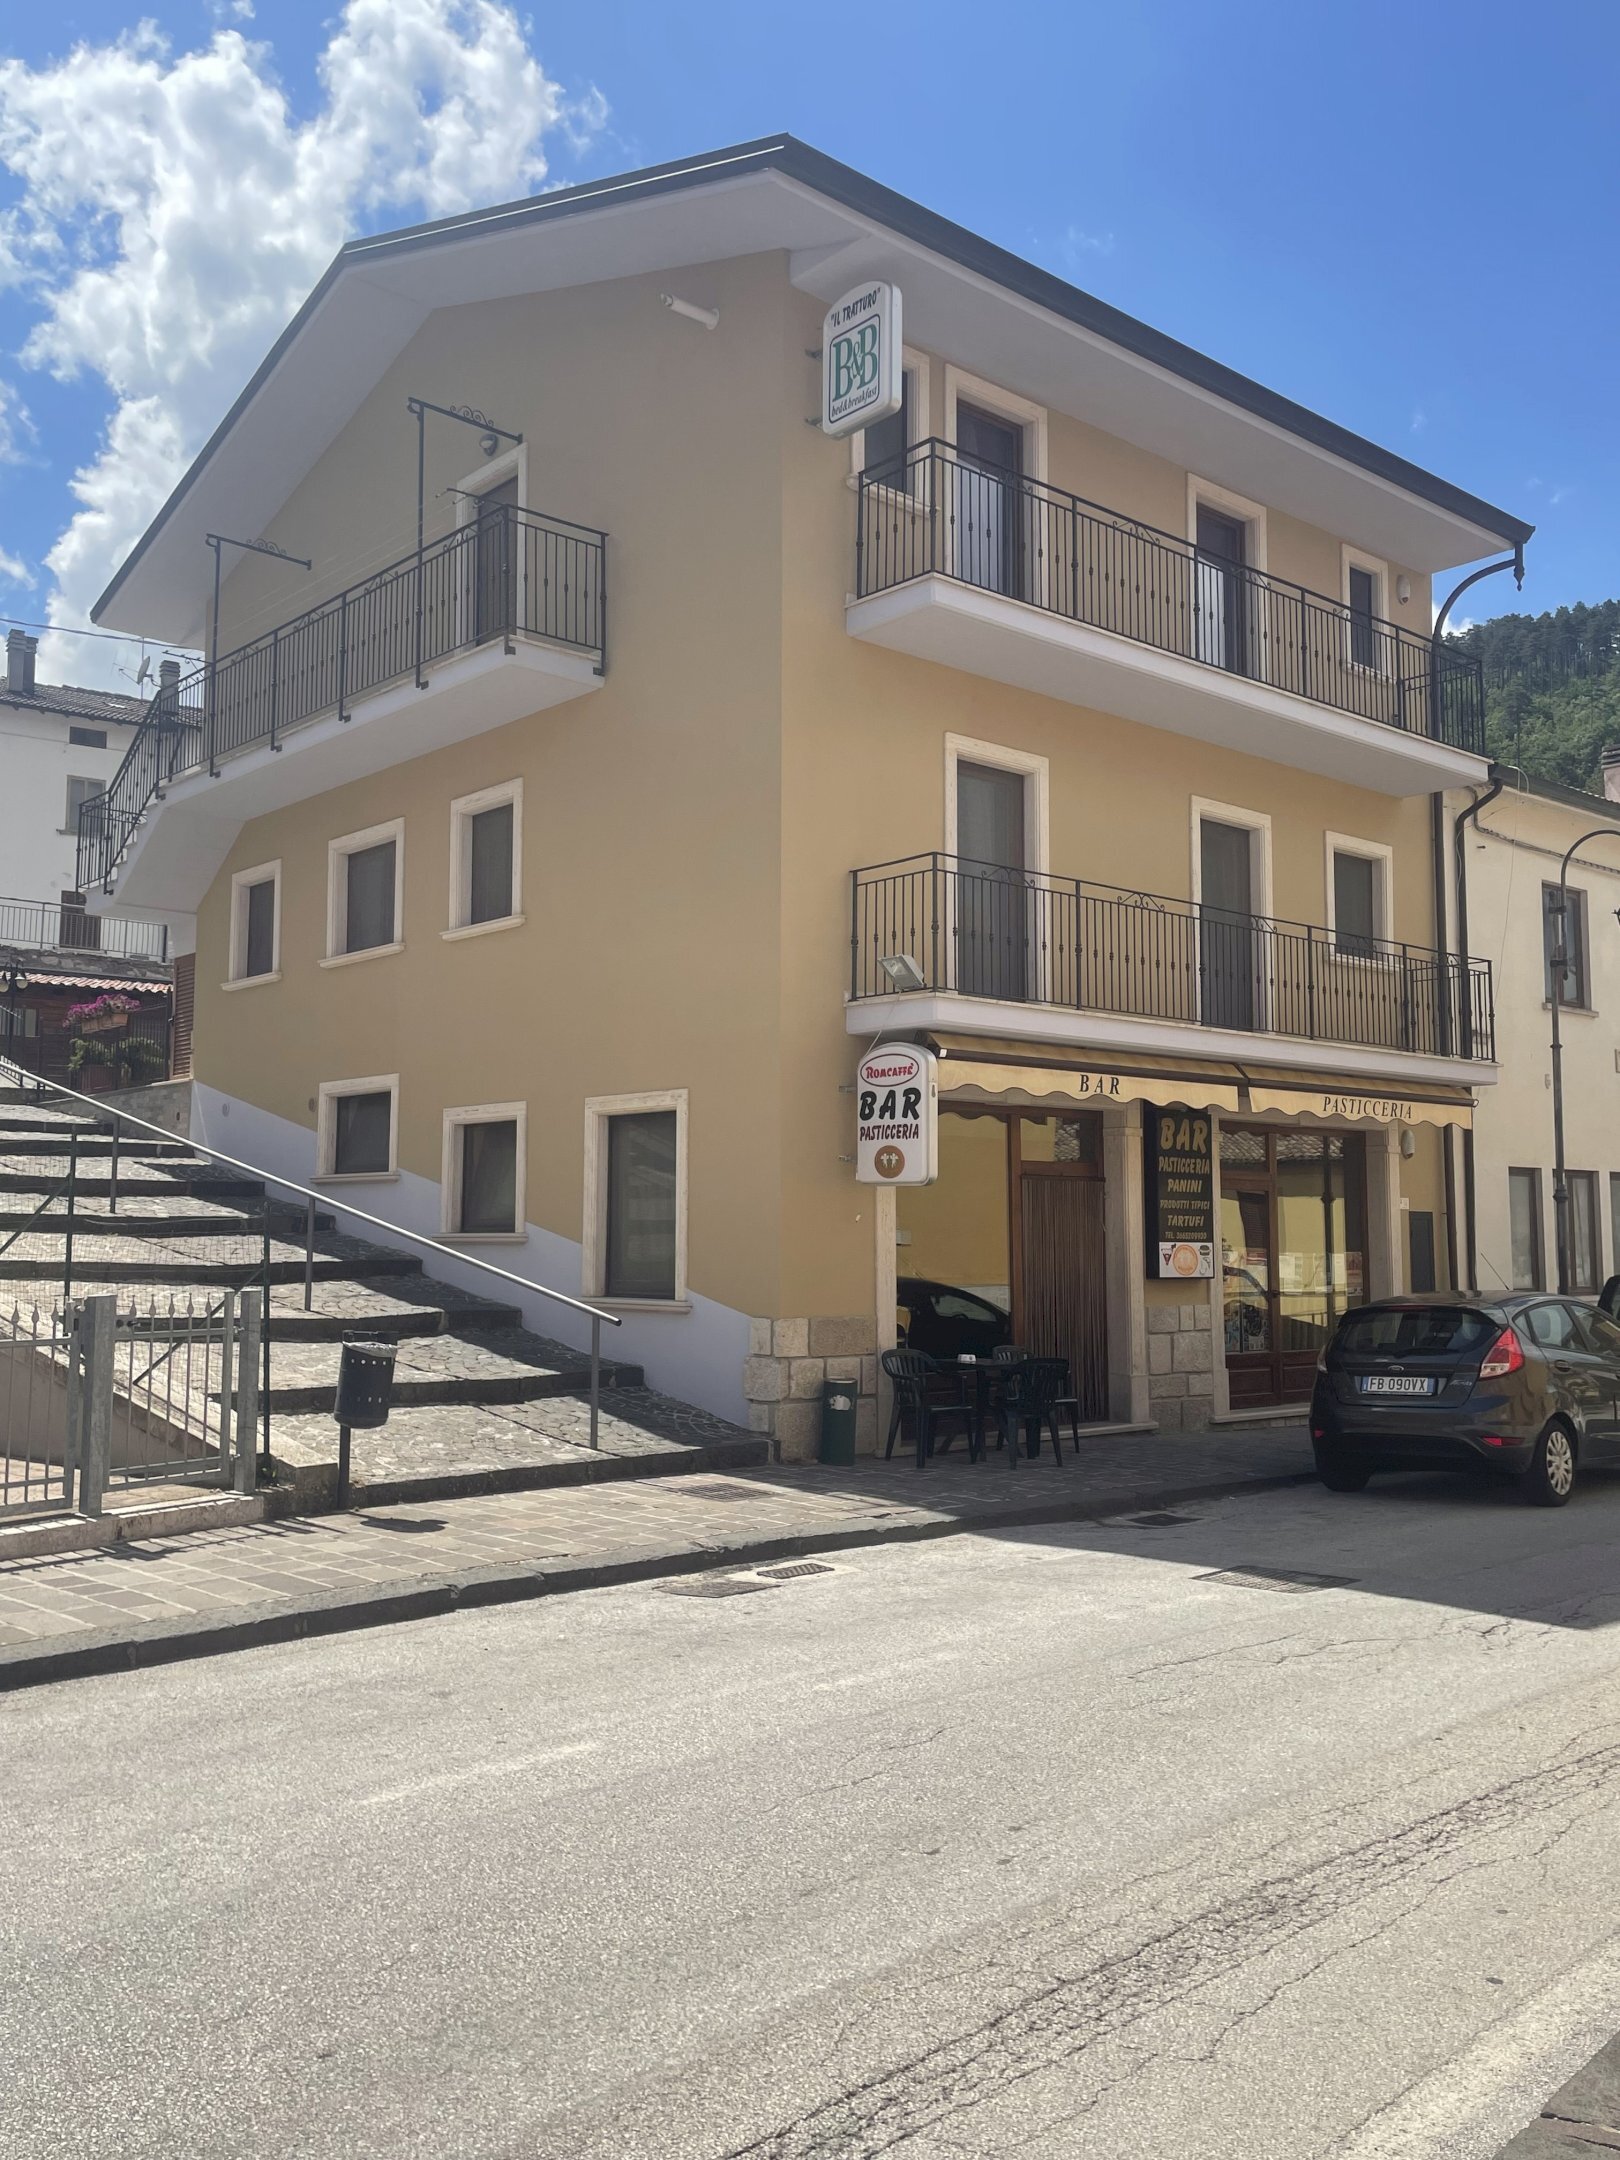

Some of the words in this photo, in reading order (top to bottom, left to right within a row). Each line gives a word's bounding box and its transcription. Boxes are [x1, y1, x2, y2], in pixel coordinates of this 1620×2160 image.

[842, 287, 882, 322] TRATTURO"
[832, 323, 878, 402] B&B
[1079, 1073, 1121, 1096] BAR
[859, 1087, 921, 1121] BAR
[1323, 1096, 1413, 1120] PASTICCERIA
[859, 1123, 920, 1142] PASTICCERIA
[1160, 1117, 1208, 1154] BAR
[1158, 1157, 1210, 1175] PASTICCERIA
[1167, 1178, 1202, 1193] PANINI
[1160, 1199, 1189, 1209] PRODOTTI
[1190, 1200, 1210, 1210] TIPICI
[1167, 1215, 1205, 1228] TARTUFI
[1369, 1377, 1385, 1390] FB
[1388, 1378, 1426, 1392] 090VX
